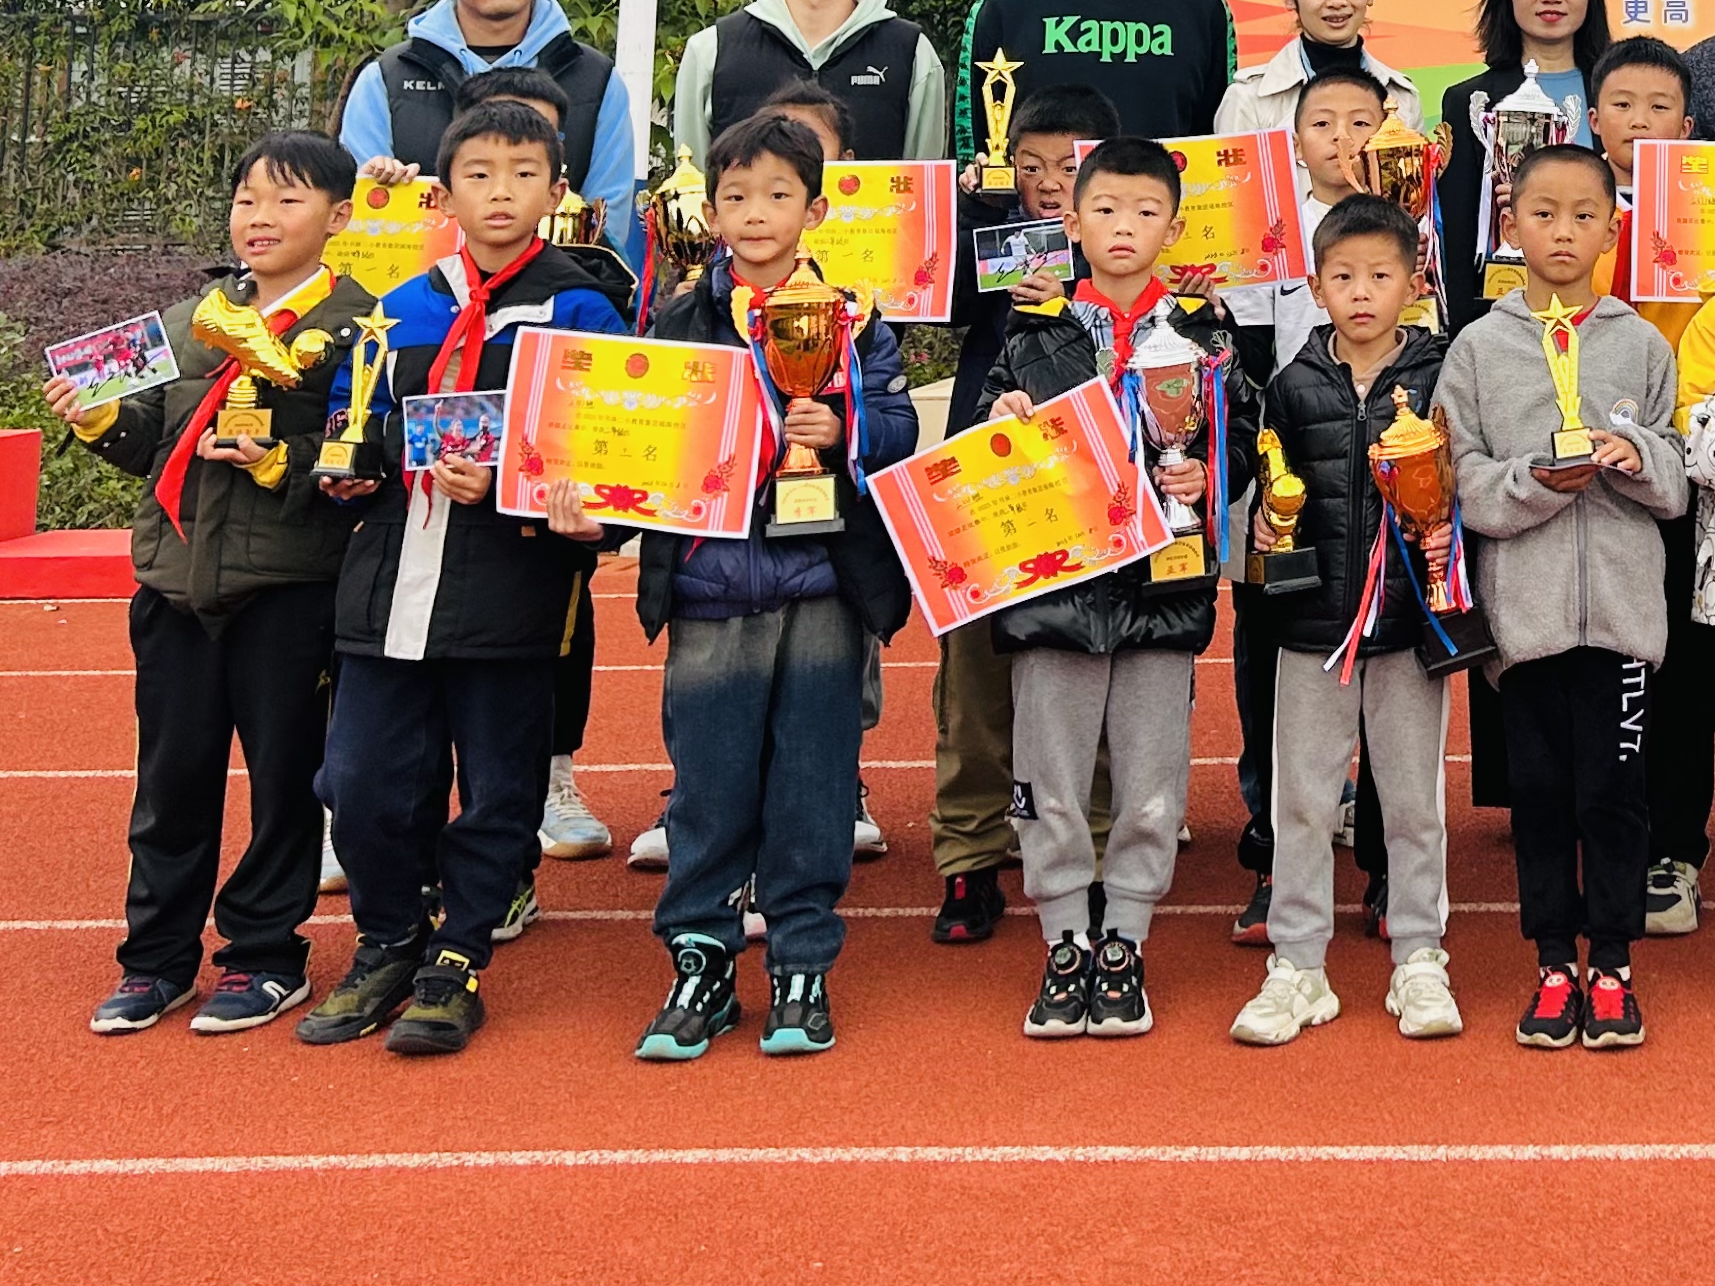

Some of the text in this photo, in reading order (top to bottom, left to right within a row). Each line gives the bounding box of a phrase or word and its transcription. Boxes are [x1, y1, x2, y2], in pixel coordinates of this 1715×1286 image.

[1042, 15, 1174, 62] Kappa
[815, 248, 875, 263] 第一名
